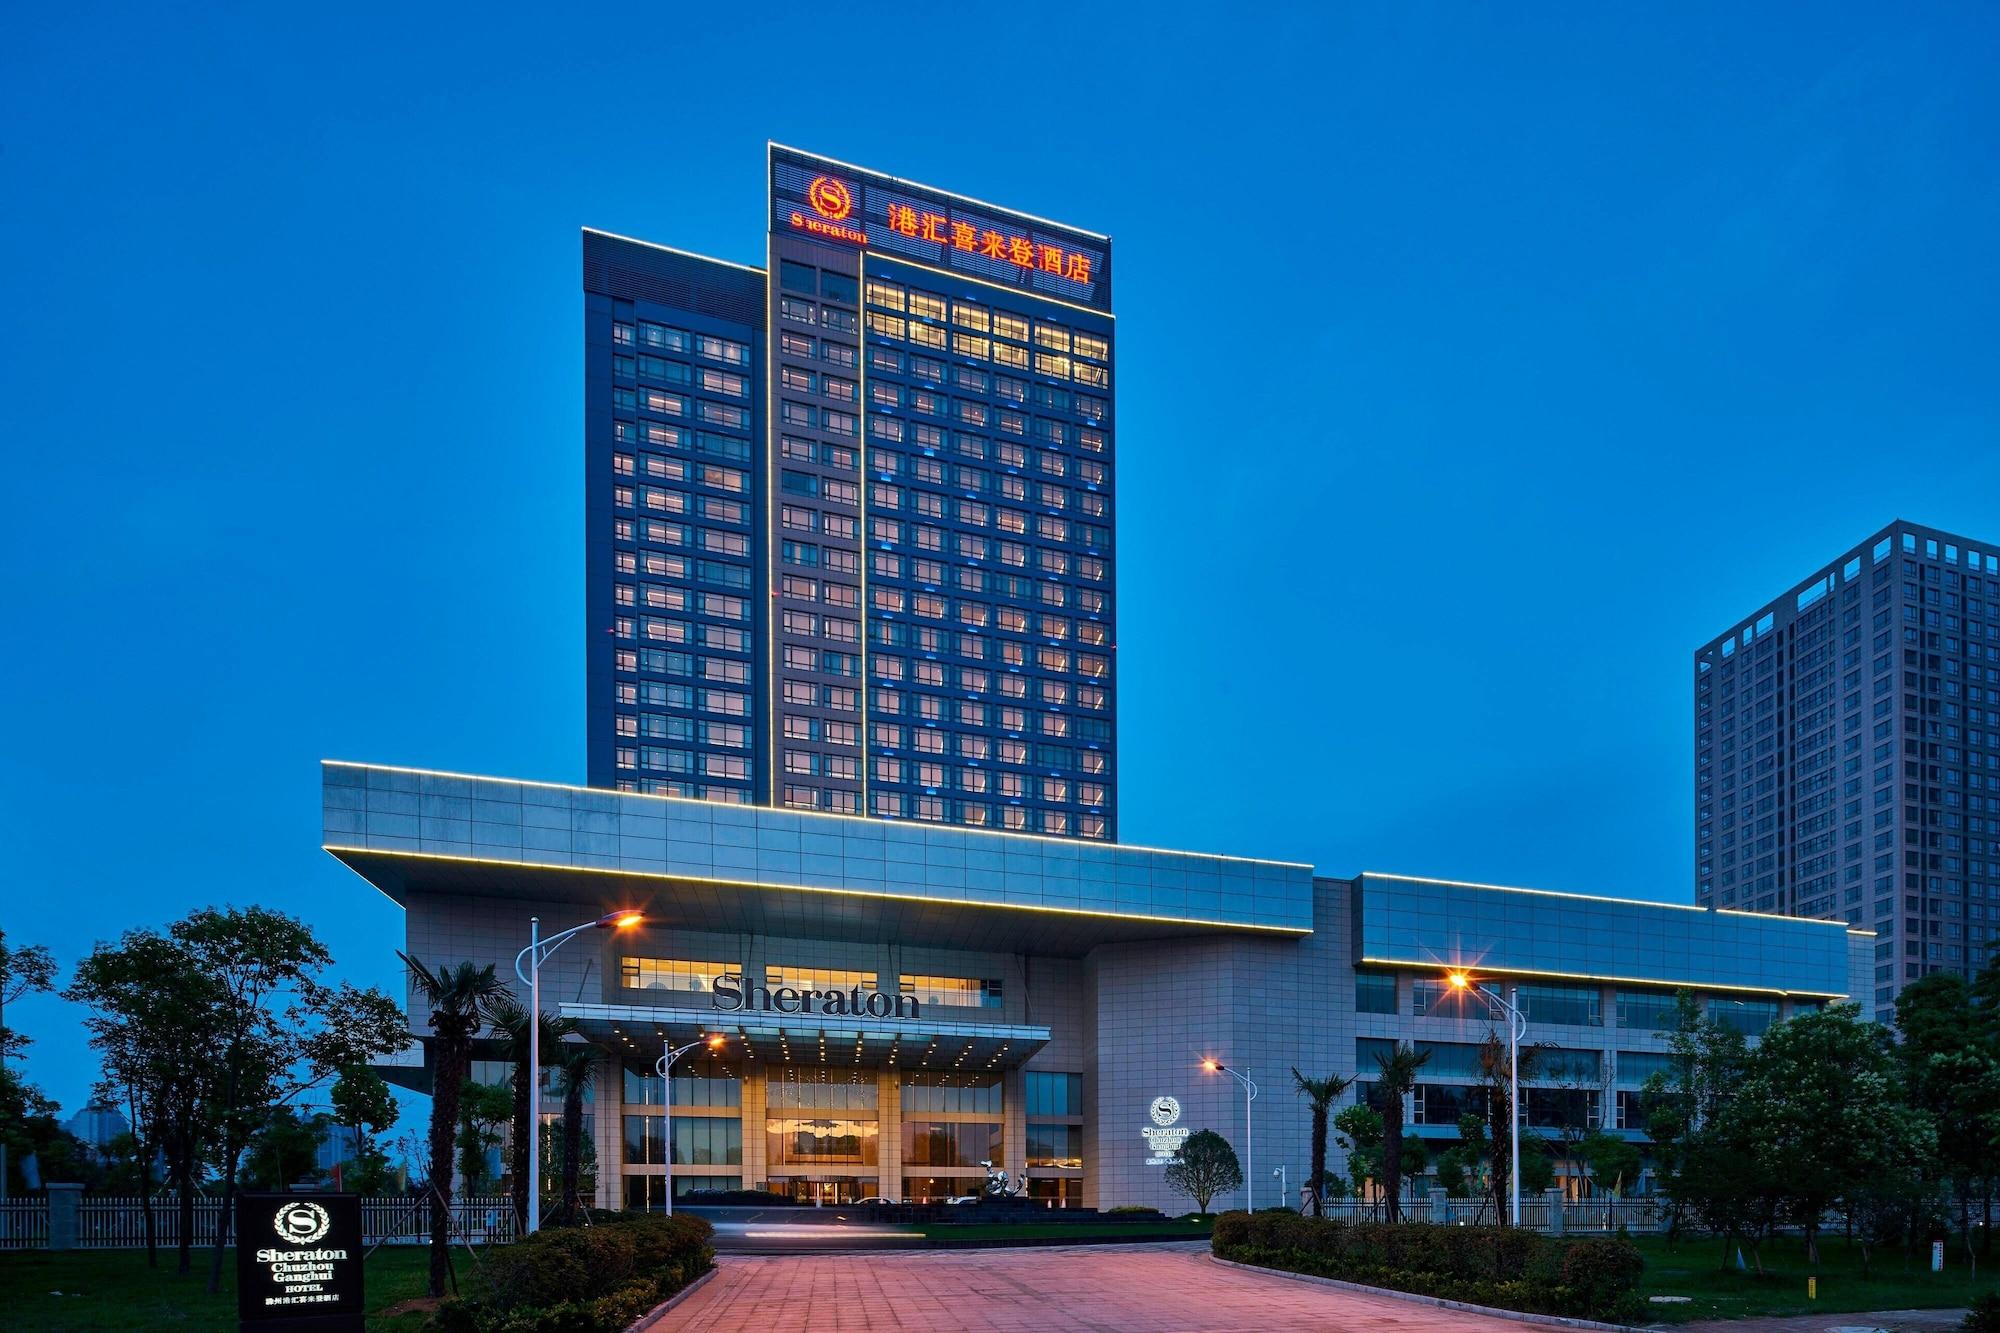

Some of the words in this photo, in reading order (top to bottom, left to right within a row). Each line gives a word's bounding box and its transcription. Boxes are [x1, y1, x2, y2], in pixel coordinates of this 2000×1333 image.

[820, 184, 842, 210] S
[887, 203, 1091, 285] 港汇喜来登酒店
[712, 975, 921, 1019] Sheraton
[1158, 1103, 1172, 1117] S
[1142, 1127, 1188, 1137] Sheraton
[288, 1209, 317, 1234] S
[256, 1249, 347, 1263] Sheraton
[271, 1262, 334, 1273] Chuzhou
[273, 1271, 333, 1282] Ganghui
[285, 1284, 323, 1293] HOTEL
